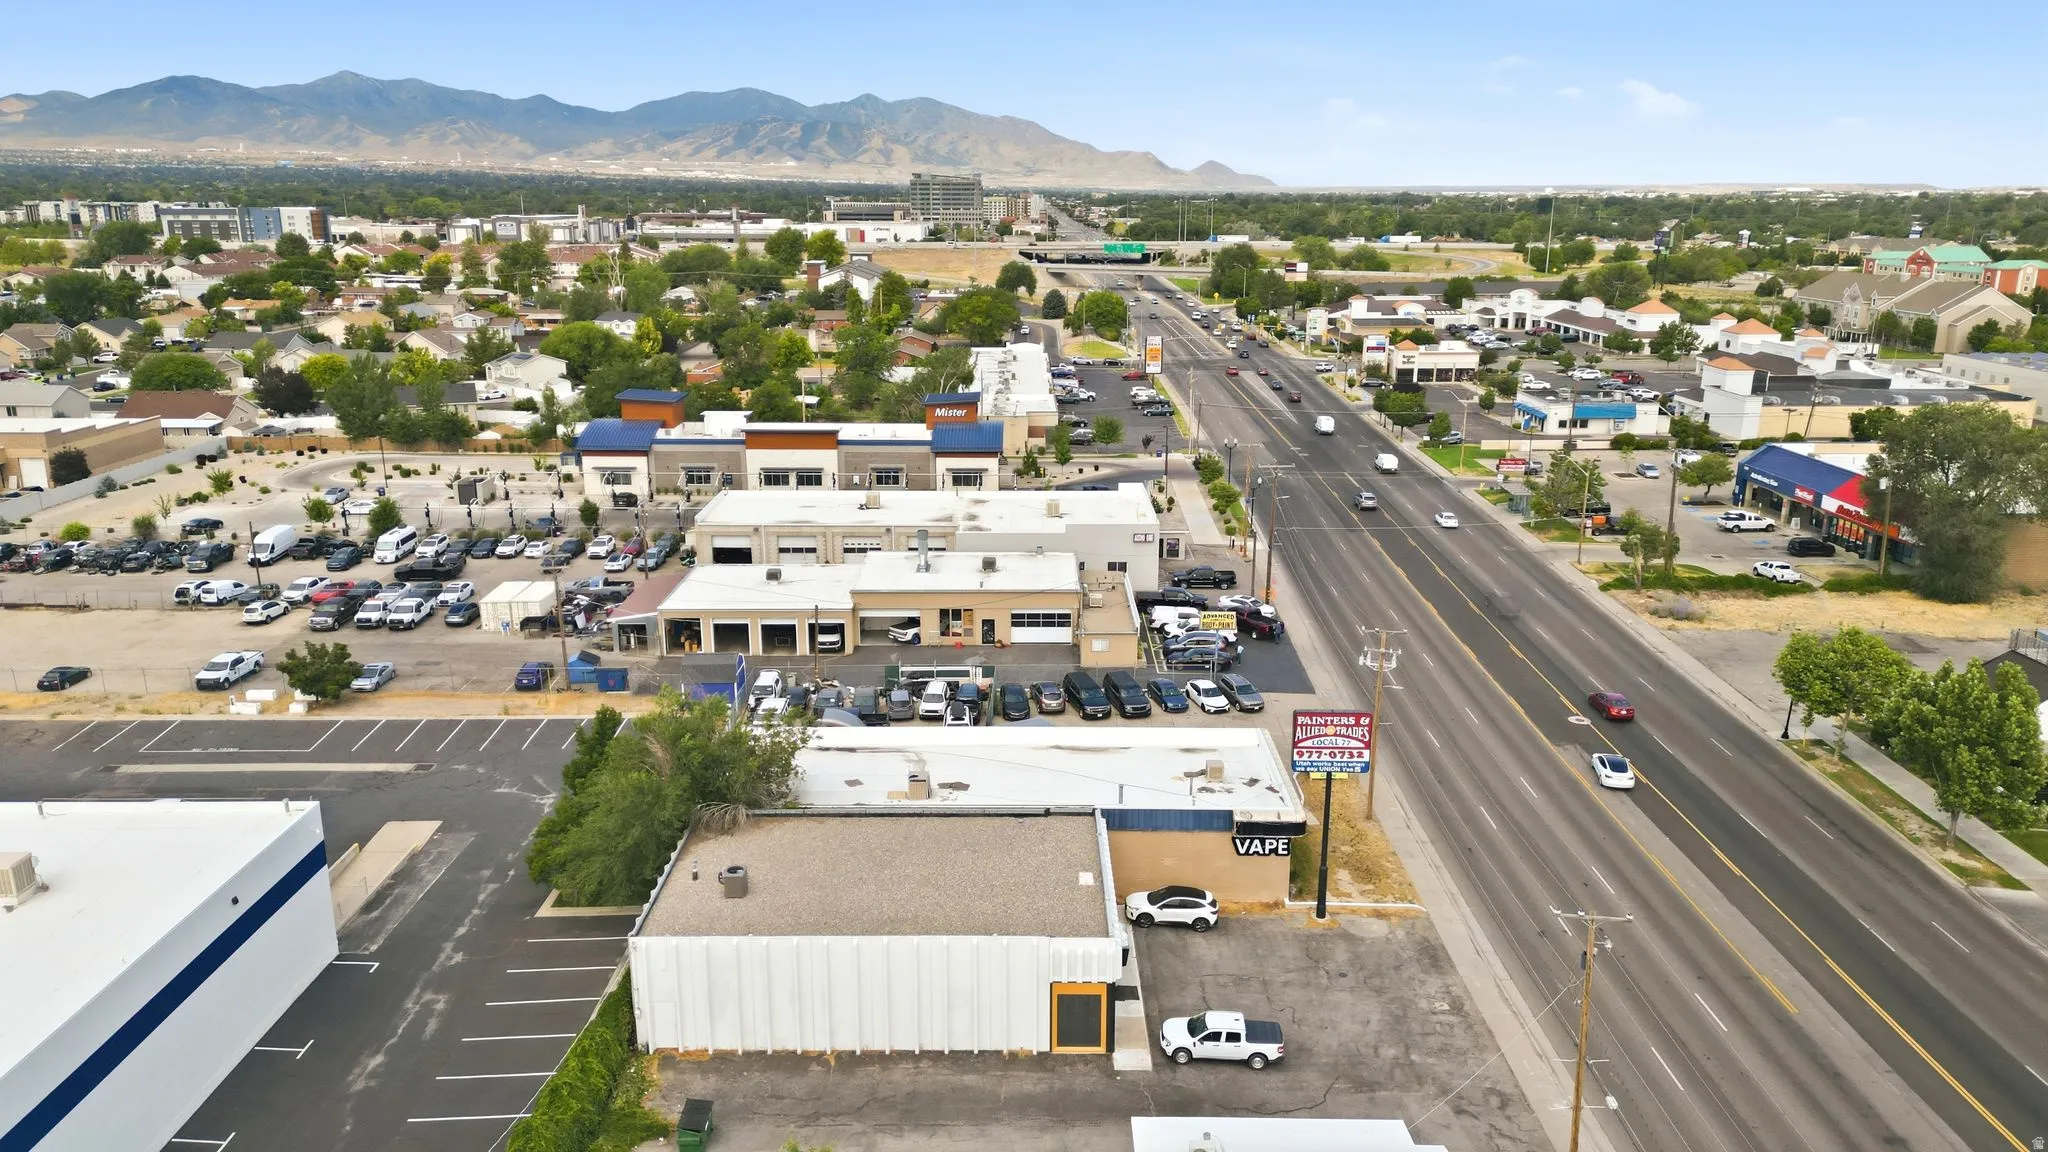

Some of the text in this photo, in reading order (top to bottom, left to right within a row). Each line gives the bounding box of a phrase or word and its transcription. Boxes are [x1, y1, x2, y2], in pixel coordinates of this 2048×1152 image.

[935, 408, 967, 416] Mister
[1297, 716, 1370, 725] PAINTERS &
[1295, 725, 1369, 742] ALLIED TRADES
[1296, 750, 1364, 759] 977-0732
[1235, 838, 1288, 854] VAPE
